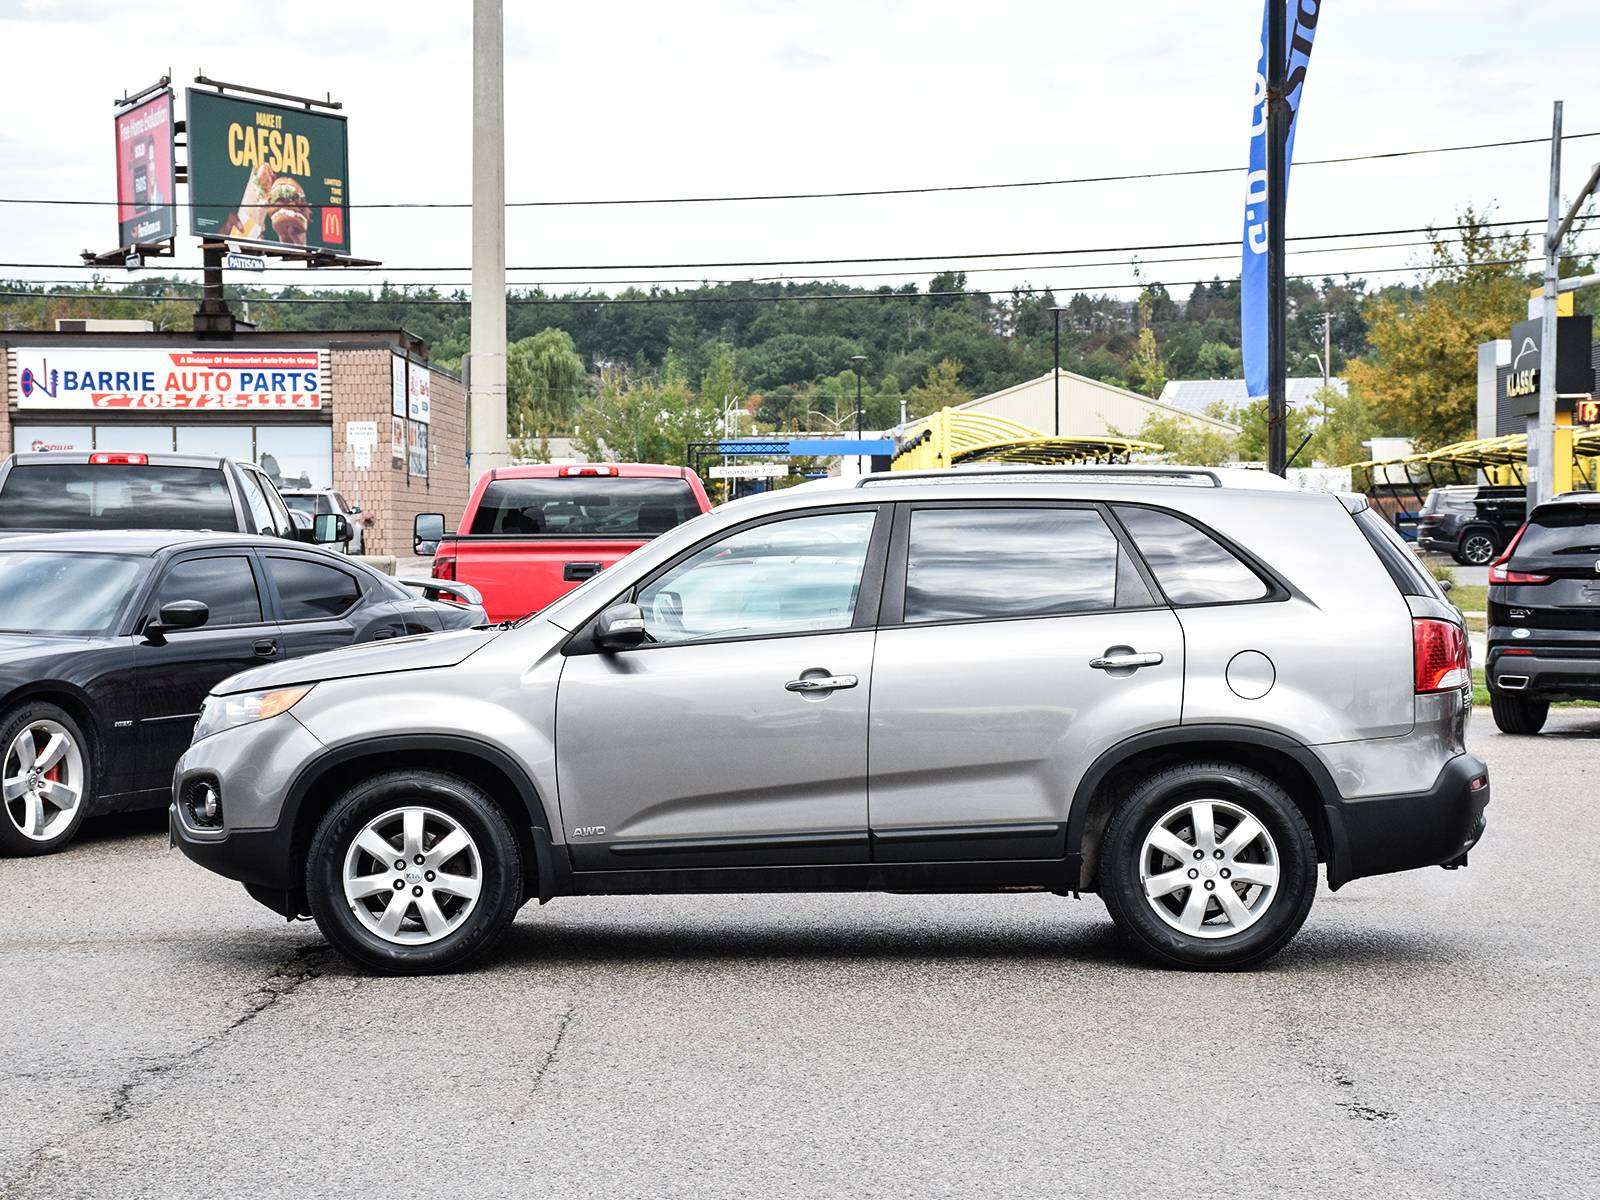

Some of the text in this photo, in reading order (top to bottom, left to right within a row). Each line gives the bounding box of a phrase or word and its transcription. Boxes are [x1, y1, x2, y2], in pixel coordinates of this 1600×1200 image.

[256, 112, 282, 129] MAKE IT
[228, 122, 311, 177] CAESAR
[229, 256, 263, 269] PATTISON
[297, 358, 317, 366] Group
[63, 371, 318, 392] BARRIE AUTO PARTS
[1506, 368, 1537, 398] KLASSIC
[129, 393, 313, 408] 705-725-1114
[572, 825, 606, 838] AWD
